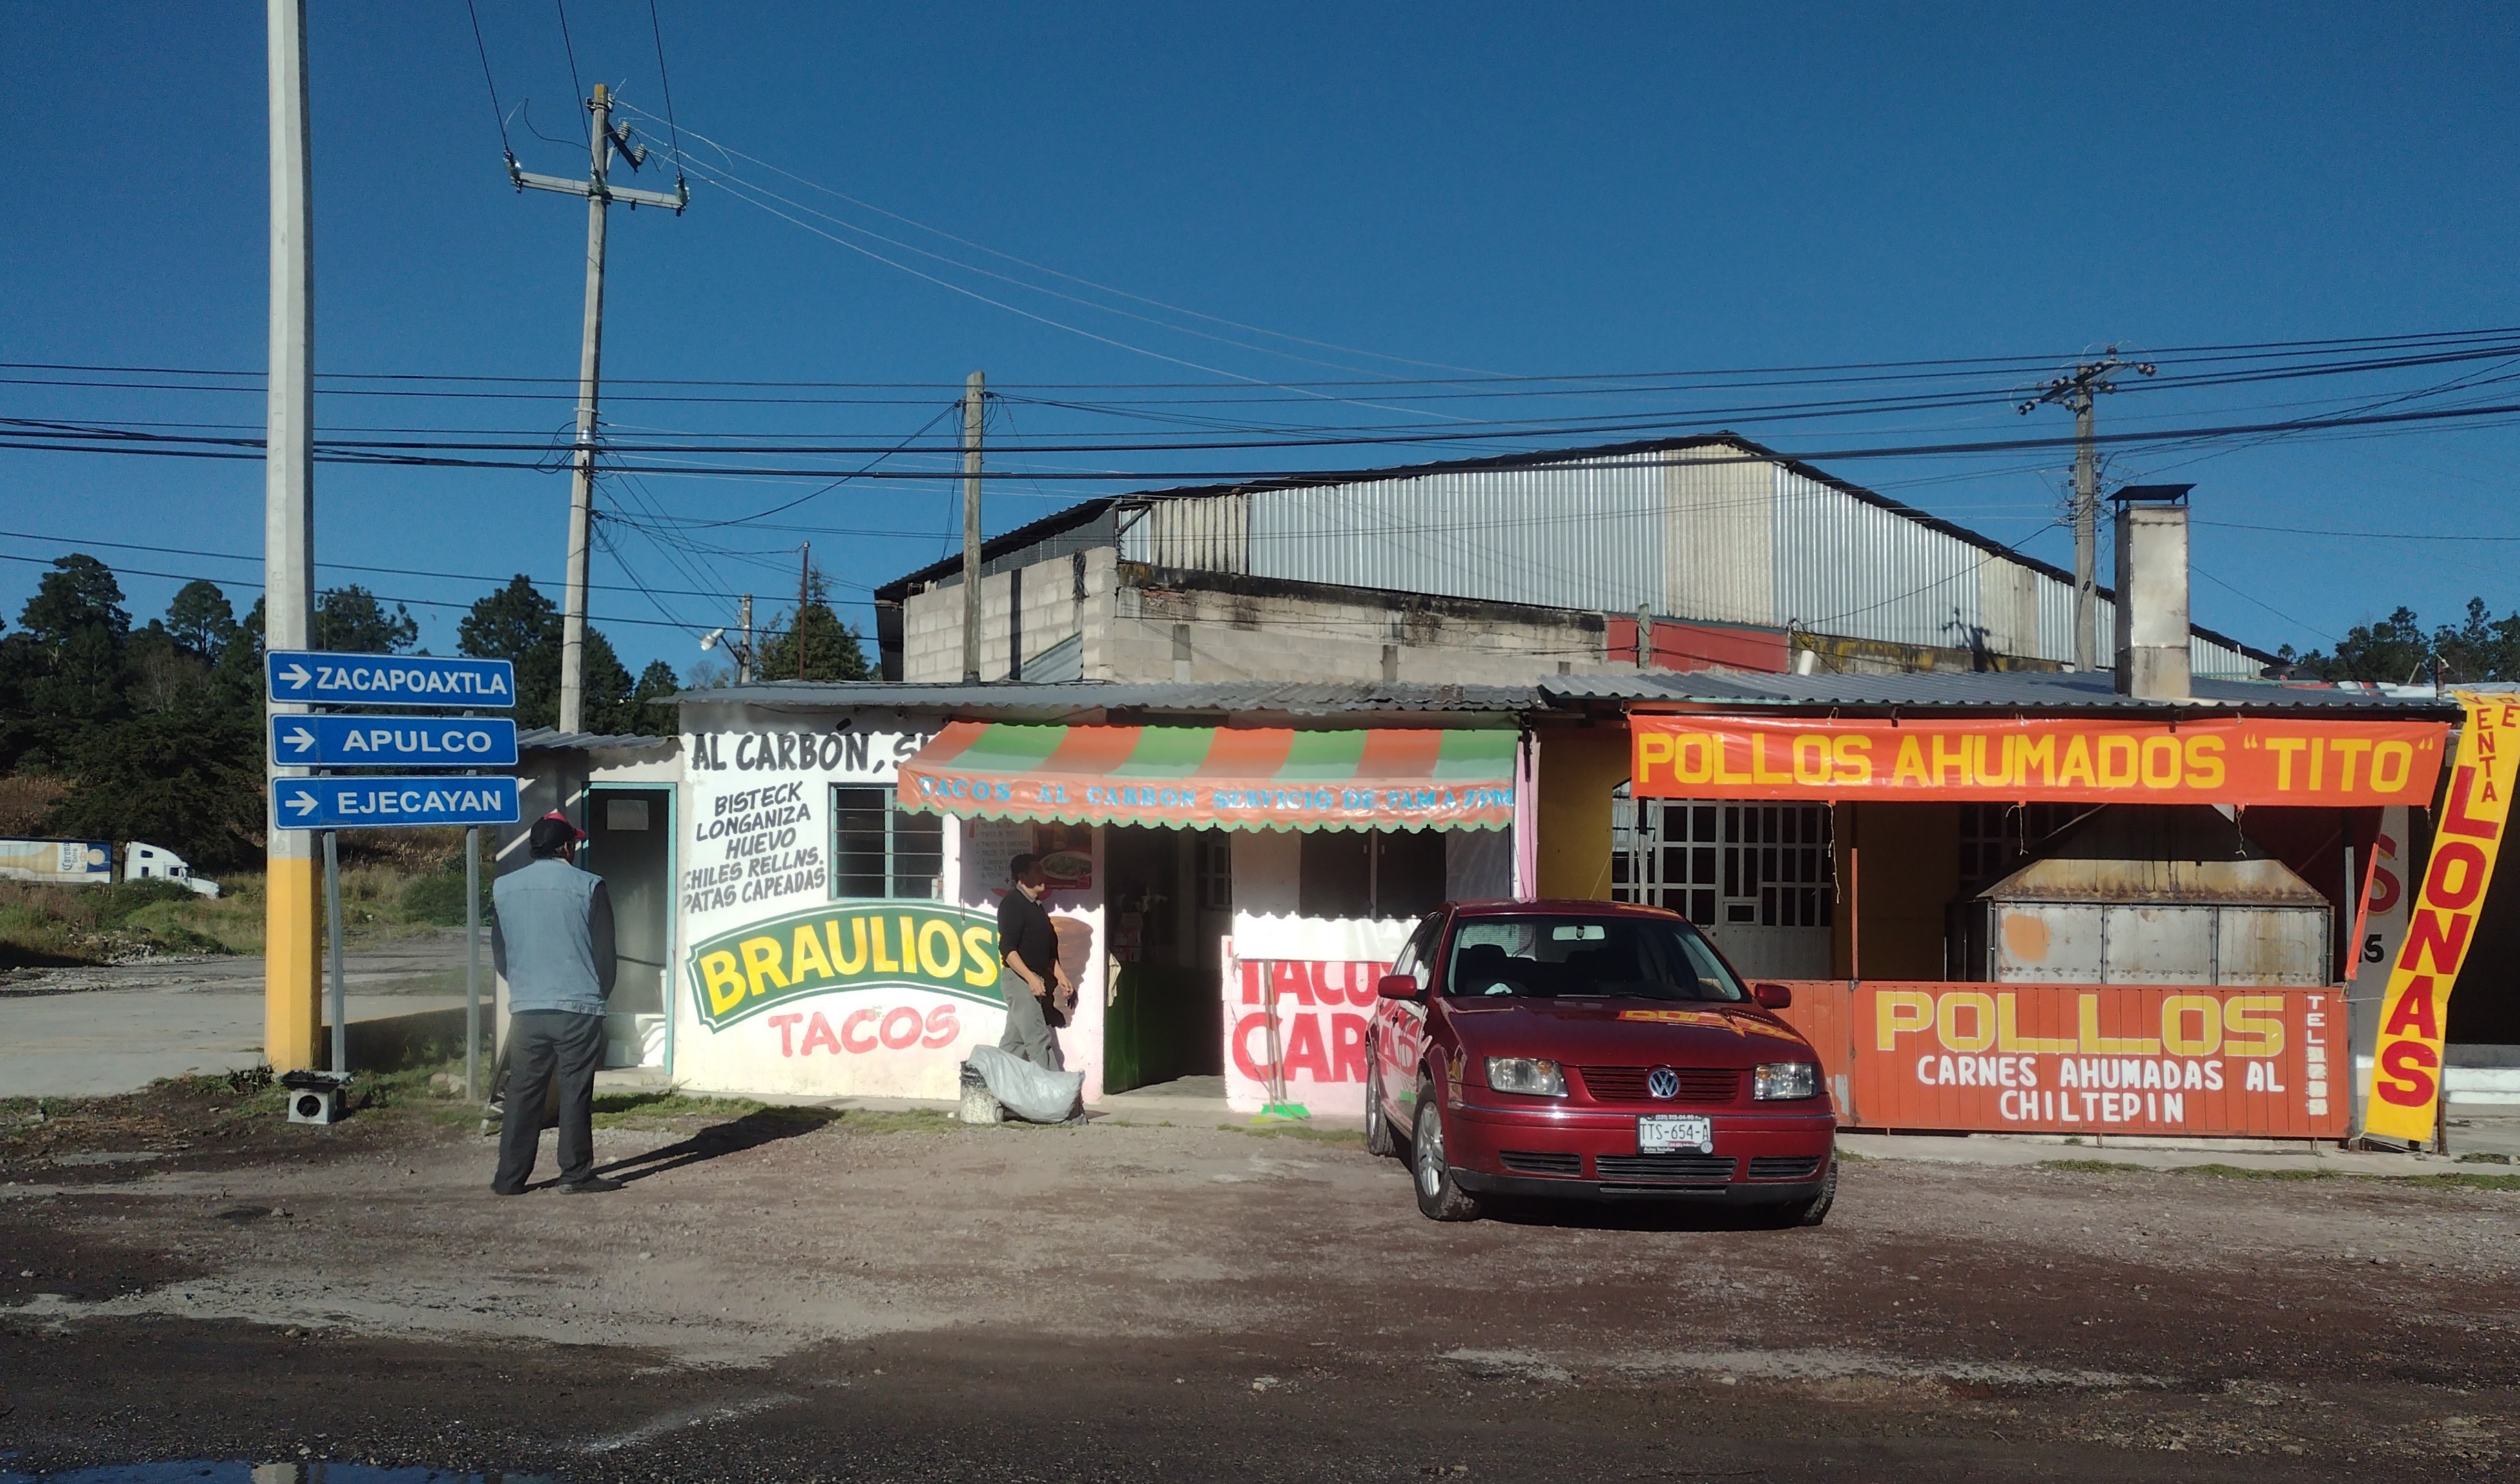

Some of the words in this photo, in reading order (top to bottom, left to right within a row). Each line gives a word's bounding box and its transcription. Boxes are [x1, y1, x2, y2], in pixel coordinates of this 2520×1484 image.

[316, 666, 508, 695] ZACAPOAXTLA
[342, 730, 492, 752] APULCO
[691, 734, 727, 771] AL
[735, 734, 885, 774] CARBON,
[892, 734, 929, 771] S
[1638, 732, 1872, 787] POLLOS
[1891, 734, 2226, 790] AHUMADOS
[338, 790, 502, 815] EJECAYAN
[714, 780, 804, 818] BISTECK
[918, 776, 1012, 802] TACOS
[1036, 784, 1072, 805] AL
[1085, 786, 1197, 808] CARBON
[1212, 789, 1334, 810] SERVICIO
[1343, 789, 1380, 810] DE
[696, 803, 812, 843] LONGANIZA
[725, 827, 797, 860] HUEVO
[681, 860, 743, 892] CHILES
[747, 845, 825, 878] RELLNS.
[681, 884, 737, 917] PATAS
[741, 866, 826, 904] CAPEADAS
[2377, 765, 2499, 1108] LONAS
[699, 916, 1004, 1017] BRAULIOS
[1237, 957, 1394, 1007] TACO
[767, 1003, 961, 1058] TACOS
[1875, 991, 2285, 1058] POLLOS
[2306, 995, 2326, 1044] TEL
[1917, 1055, 2038, 1087] CARNES
[2059, 1058, 2224, 1091] AHUMADAS
[2246, 1061, 2286, 1093] AL
[2000, 1089, 2185, 1124] CHILTEPIN
[1639, 1123, 1709, 1141] TTS-654-A
